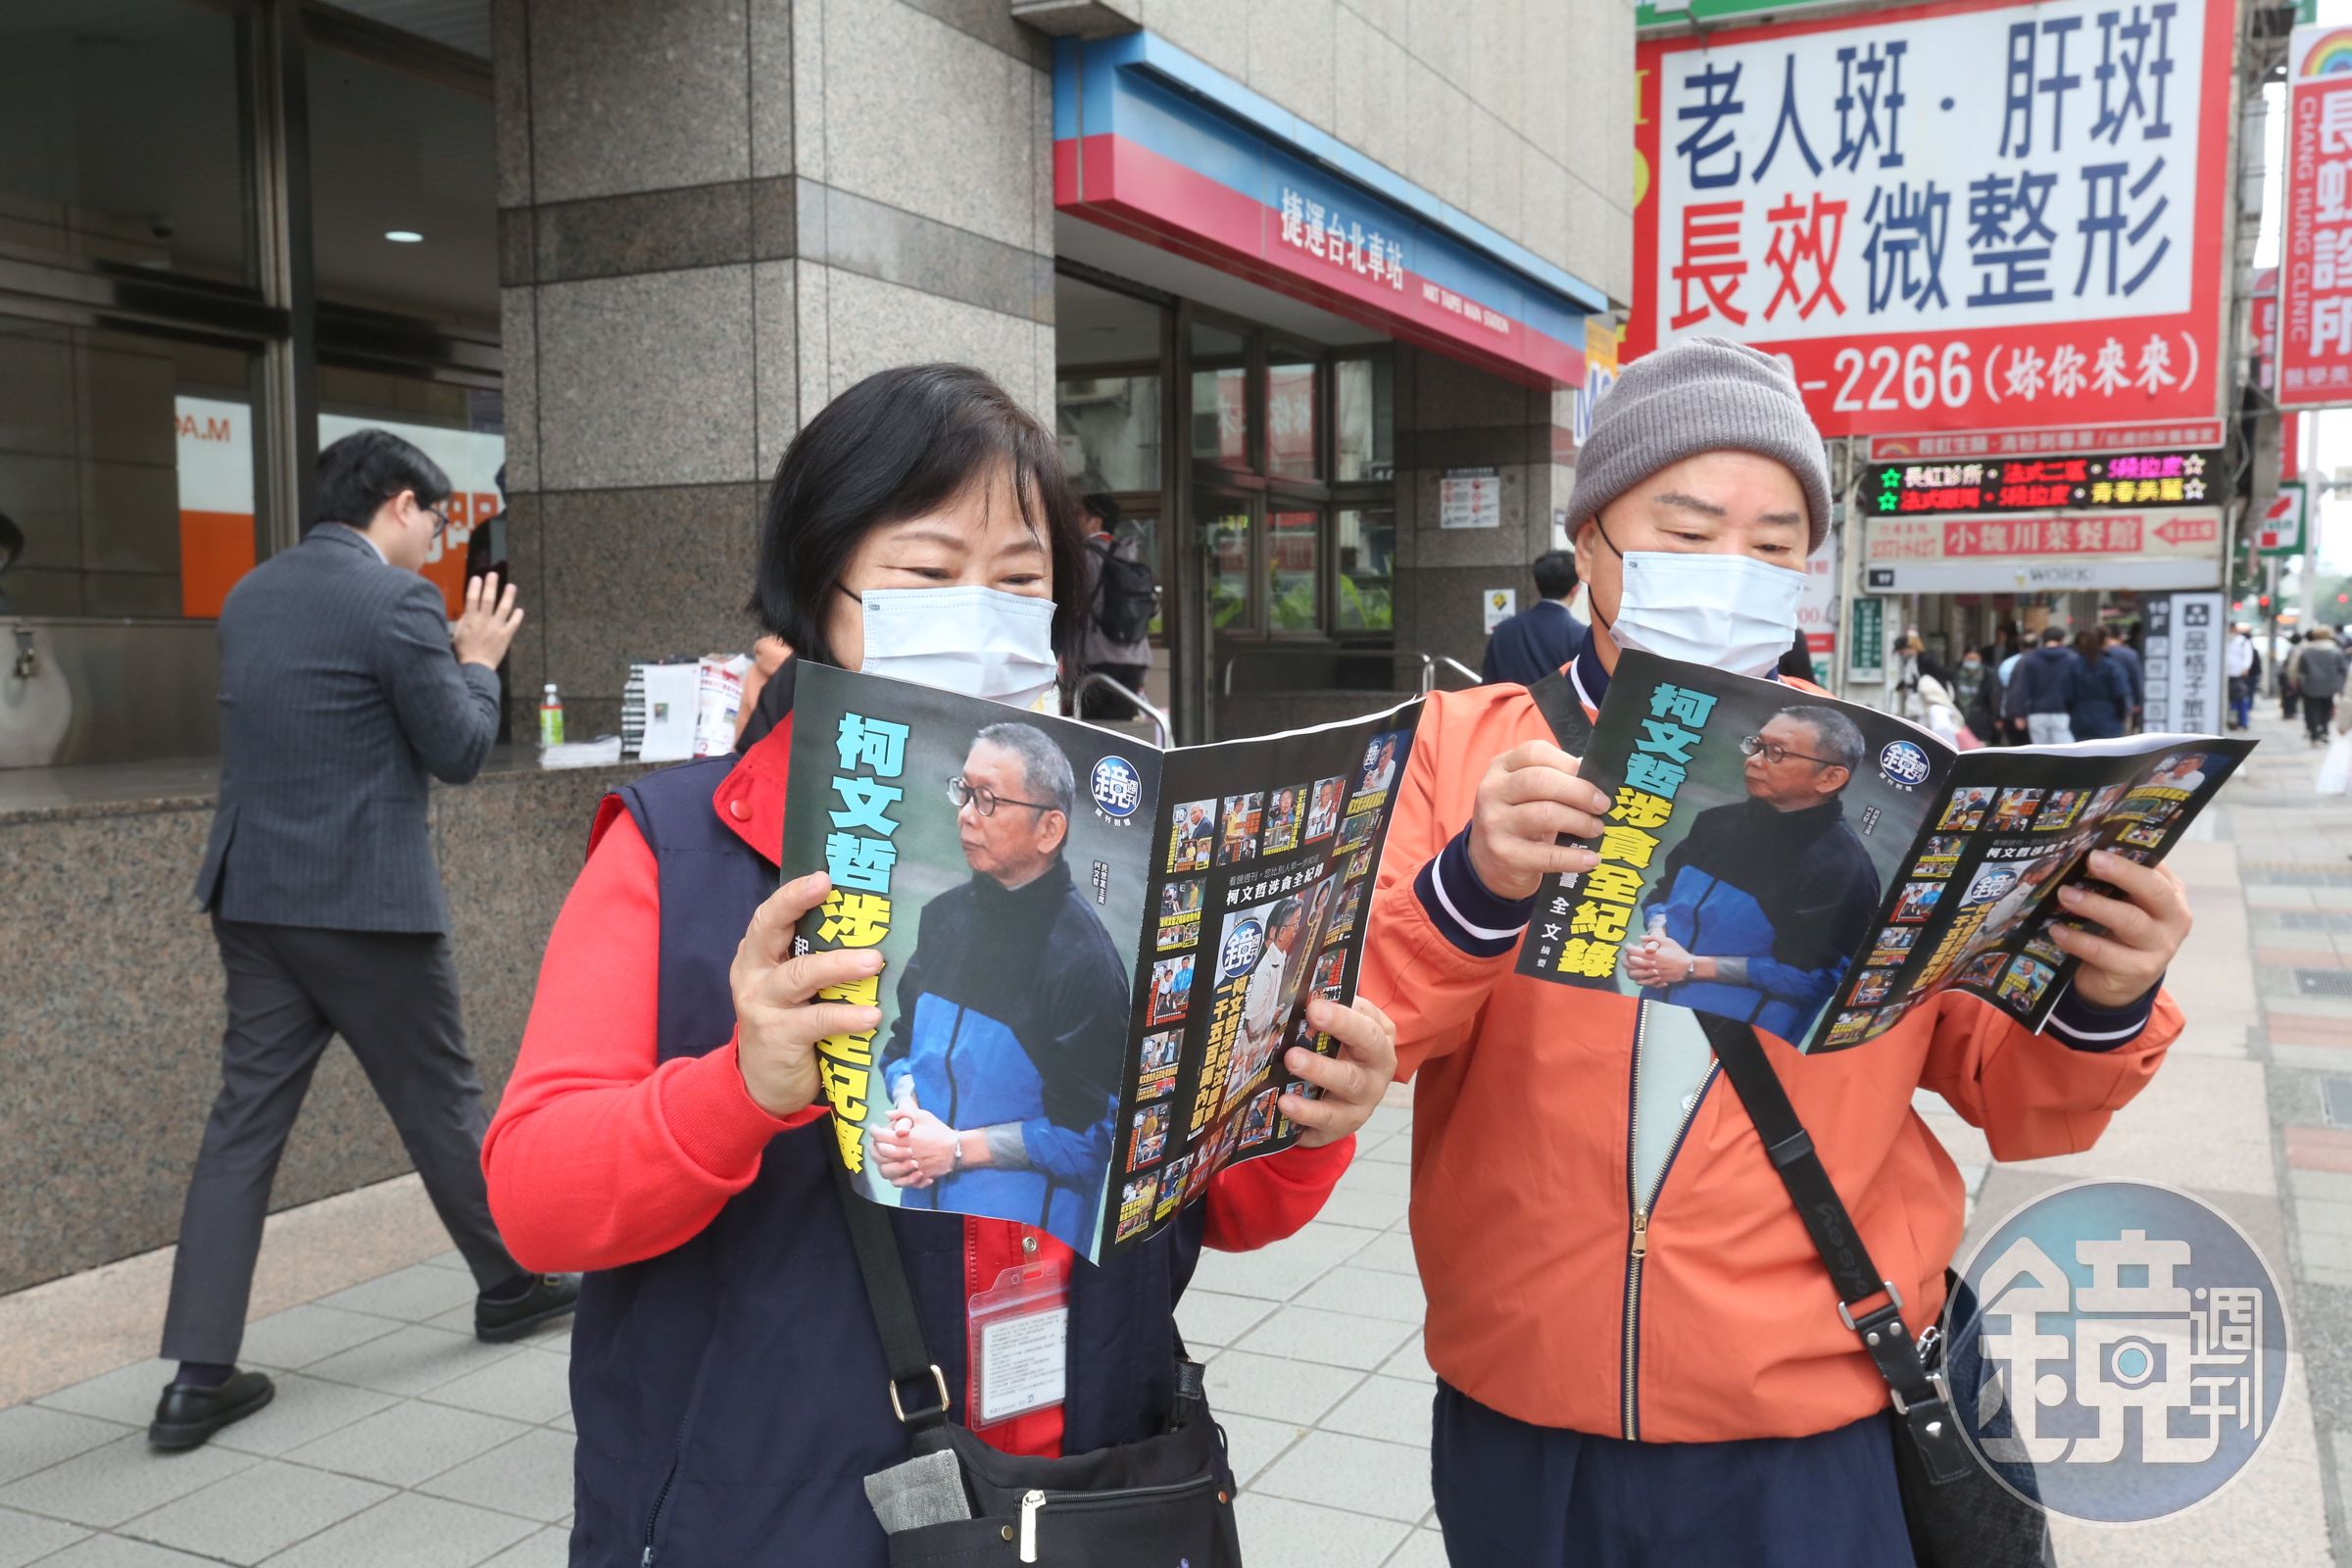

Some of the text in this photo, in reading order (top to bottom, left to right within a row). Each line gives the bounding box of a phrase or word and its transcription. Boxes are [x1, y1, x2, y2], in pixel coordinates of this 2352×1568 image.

[1282, 188, 1403, 291] 捷運台北車站
[1670, 157, 2174, 331] 長效微整形
[2290, 96, 2319, 343] CHANG HUNG CLINIC
[1947, 519, 2139, 553] 小魏川菜餐館
[1226, 862, 1324, 906] 柯文哲涉貪全紀錄
[1556, 682, 1718, 978] 柯文哲涉貪全紀錄
[1537, 843, 1588, 968] 書全文摘要
